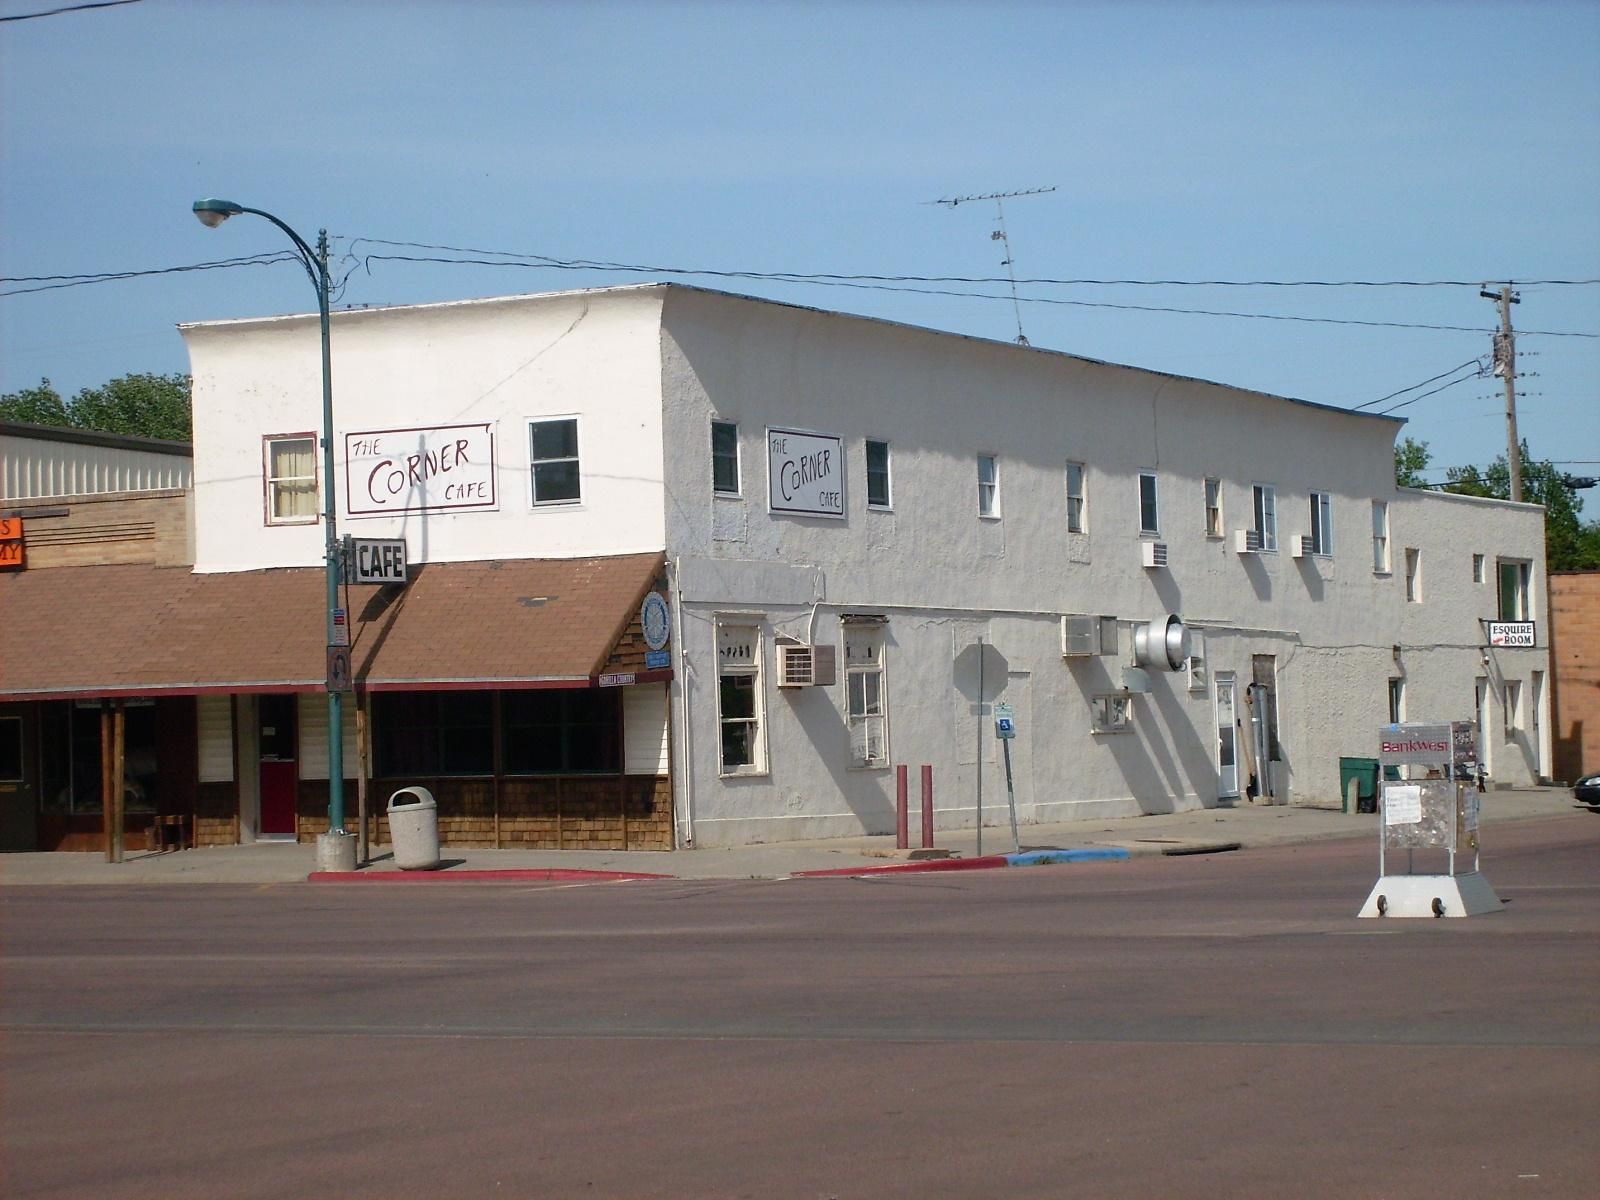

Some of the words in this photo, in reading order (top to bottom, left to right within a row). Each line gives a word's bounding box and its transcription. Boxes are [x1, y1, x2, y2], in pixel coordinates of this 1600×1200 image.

[353, 438, 381, 456] THE
[772, 438, 788, 455] THE
[367, 439, 469, 504] CORNER
[780, 449, 831, 502] CORNER
[445, 481, 488, 501] CAFE
[819, 491, 841, 508] CAFE
[359, 545, 403, 578] CAFE
[1492, 624, 1532, 636] ESQUIRE
[1504, 635, 1532, 645] ROOM
[1381, 739, 1449, 753] BankWest
